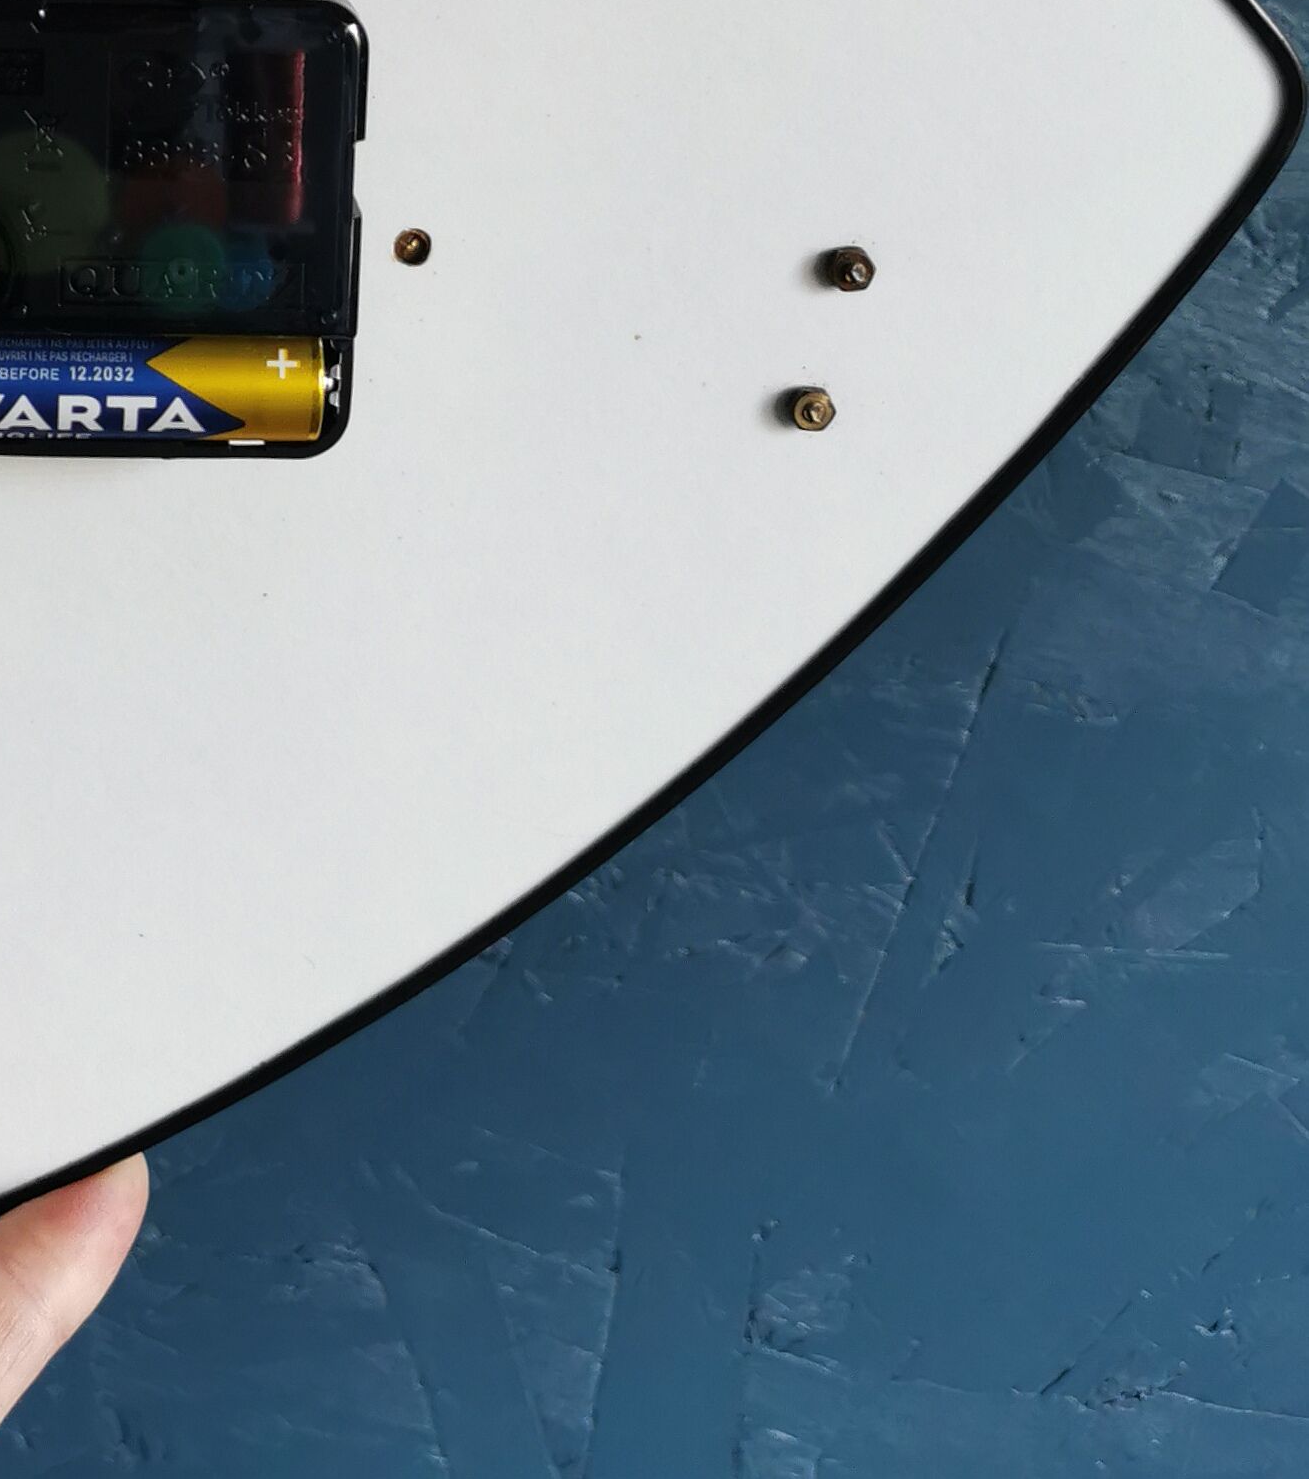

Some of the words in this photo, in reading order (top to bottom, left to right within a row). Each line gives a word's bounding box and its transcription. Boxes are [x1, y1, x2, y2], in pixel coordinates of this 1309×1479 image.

[34, 350, 48, 362] NE
[49, 350, 68, 362] PAS
[69, 350, 128, 362] RECHARGER
[69, 365, 135, 382] 12.2032
